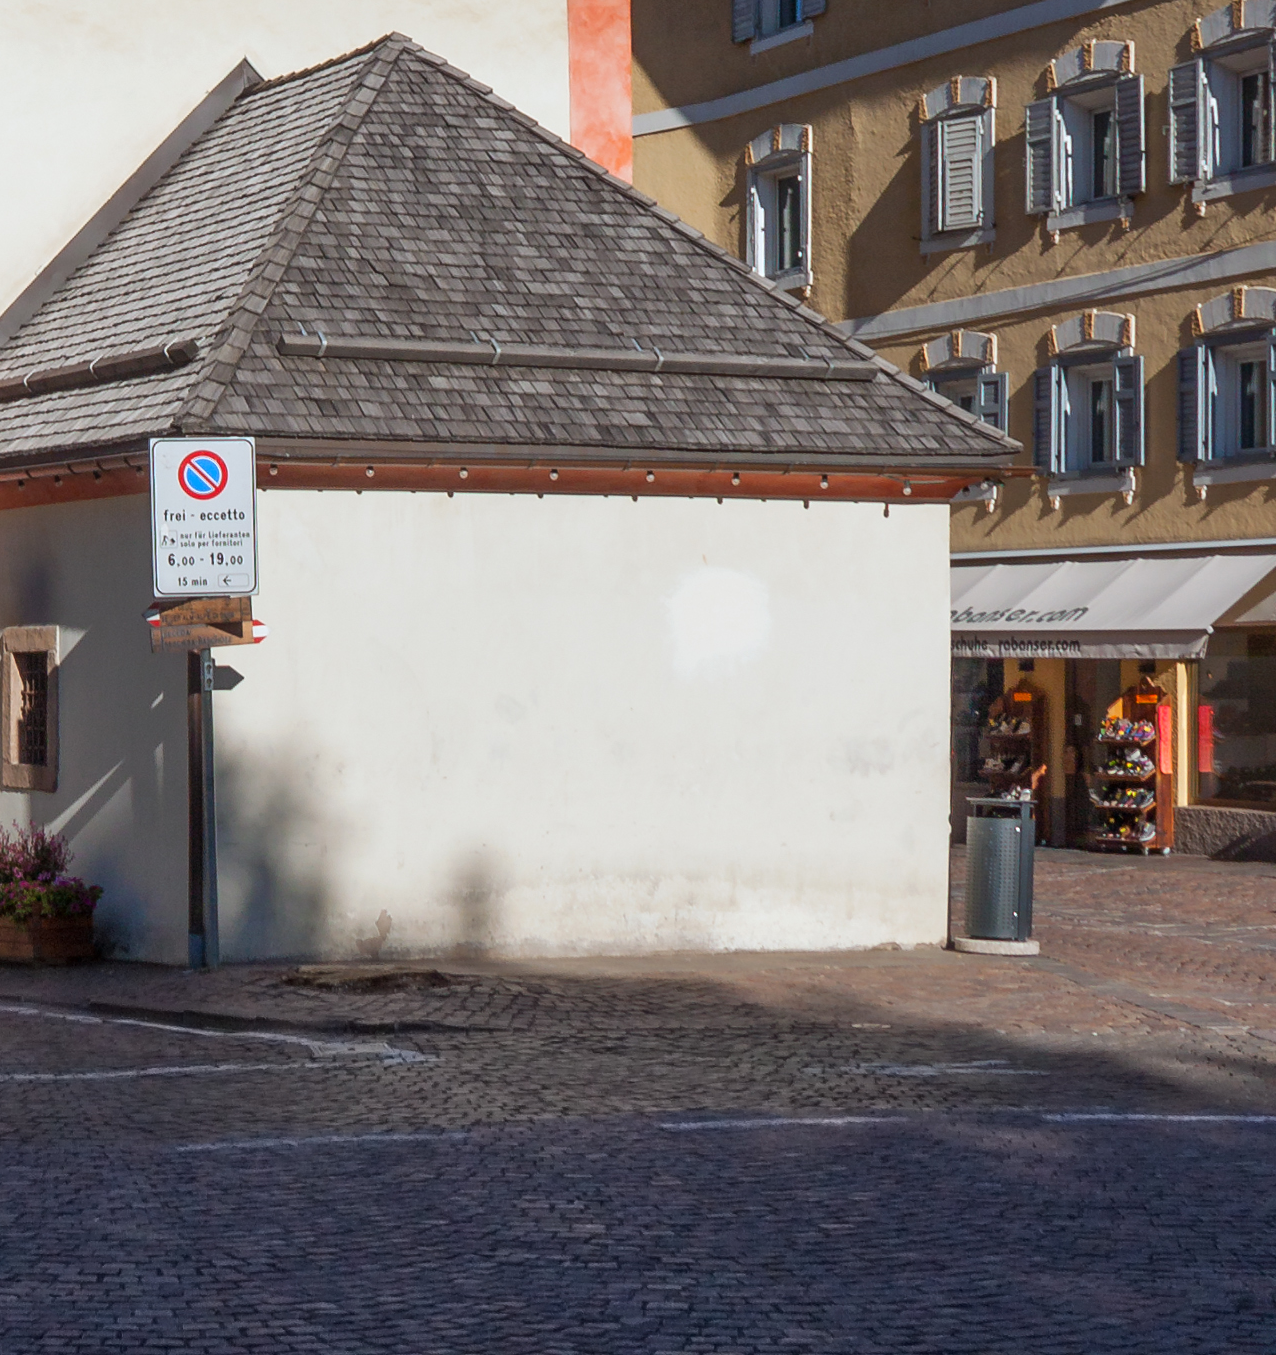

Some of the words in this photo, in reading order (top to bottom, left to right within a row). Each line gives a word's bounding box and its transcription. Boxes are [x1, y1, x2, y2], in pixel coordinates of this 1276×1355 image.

[164, 509, 186, 522] frei
[200, 509, 245, 521] eccetto
[194, 530, 206, 539] für
[208, 530, 250, 539] Lieferanten
[197, 541, 209, 549] per
[211, 539, 243, 547] fornitori
[177, 576, 188, 587] 15
[191, 575, 208, 586] min
[950, 606, 1089, 624] abanser.com
[998, 635, 1081, 653] rabanser.com
